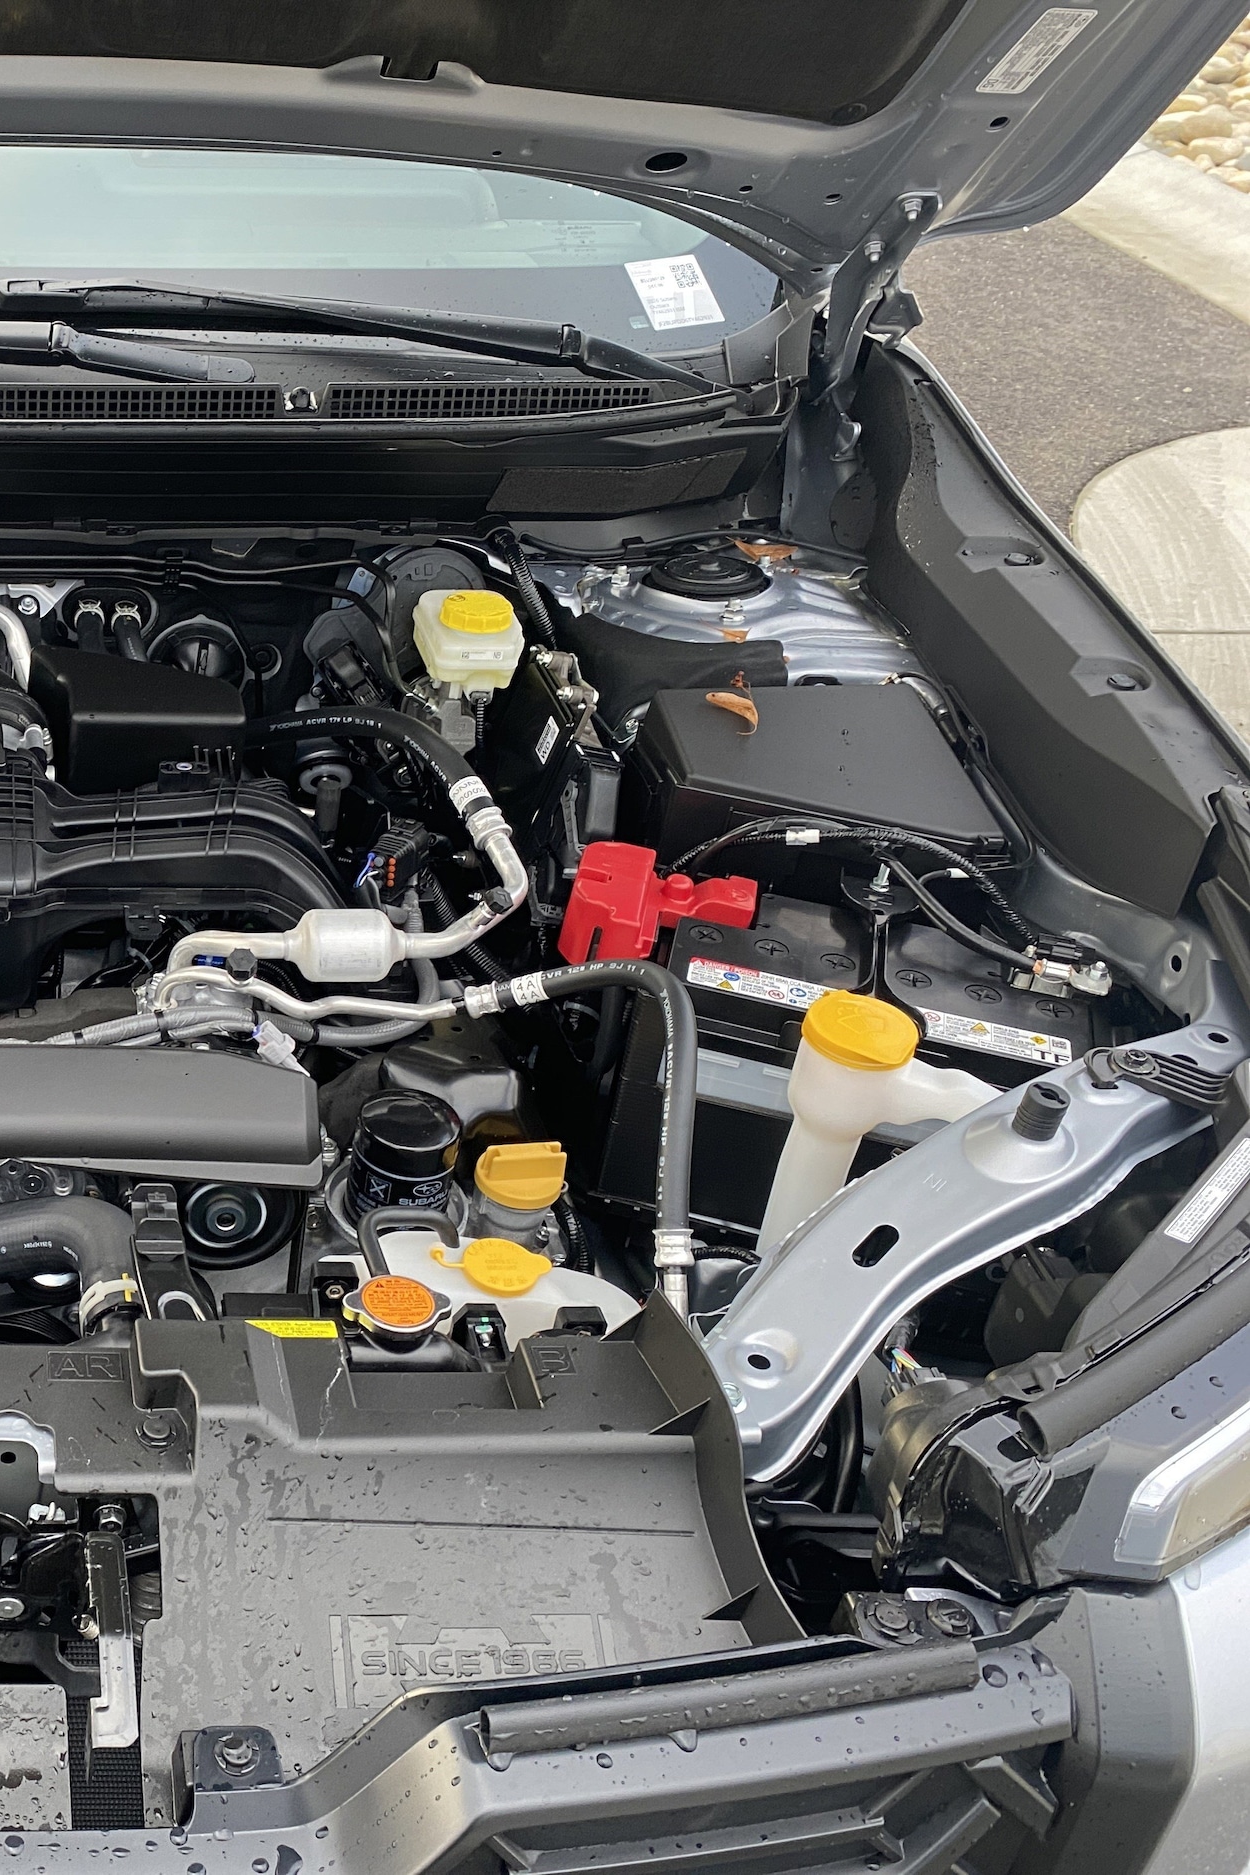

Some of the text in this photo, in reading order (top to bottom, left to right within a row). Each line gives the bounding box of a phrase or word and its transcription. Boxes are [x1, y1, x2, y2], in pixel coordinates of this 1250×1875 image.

[589, 963, 604, 971] HP
[663, 997, 674, 1039] YOKOHAMA
[666, 1049, 674, 1089] ACVR
[661, 1126, 668, 1147] HP
[399, 1189, 448, 1206] SUBARU
[54, 1354, 117, 1378] AR
[538, 1350, 570, 1372] B
